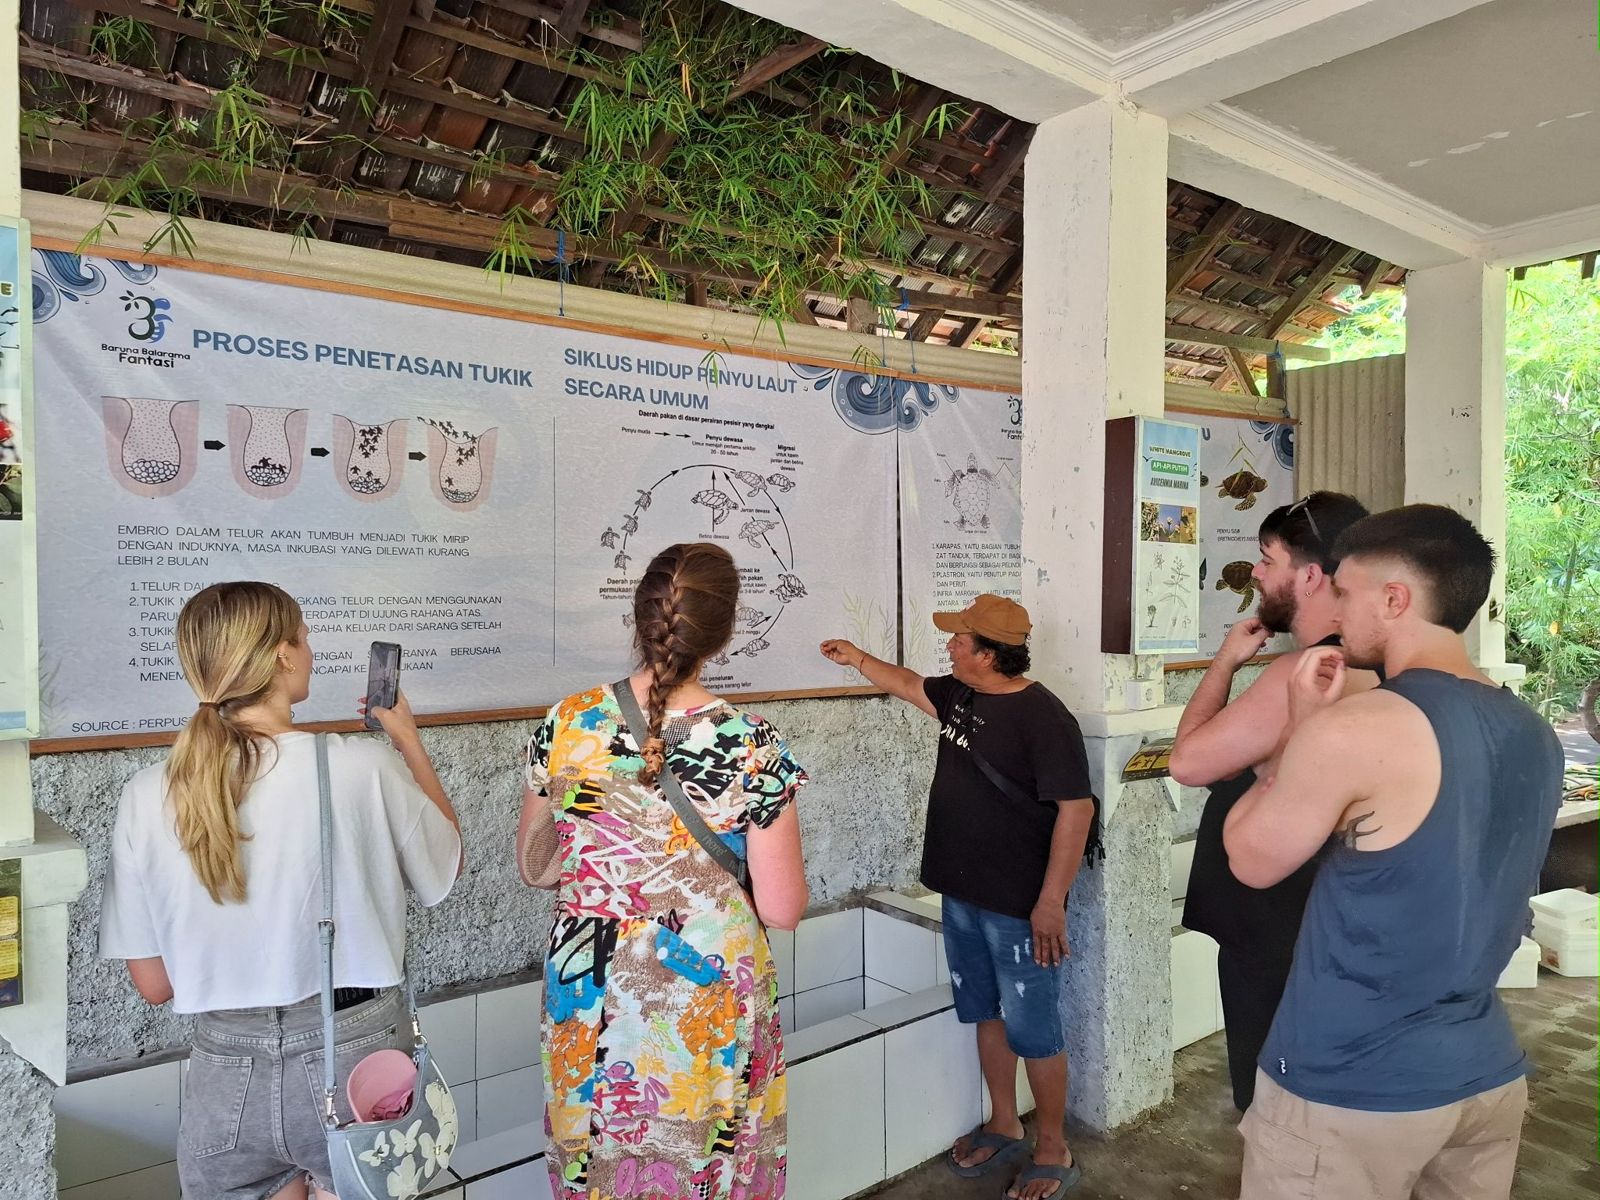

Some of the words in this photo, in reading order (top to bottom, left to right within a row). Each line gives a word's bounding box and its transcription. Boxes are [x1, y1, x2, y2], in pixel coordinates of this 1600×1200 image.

[101, 343, 139, 355] Baruna
[141, 348, 191, 360] Balarama
[119, 353, 175, 368] Fantasi
[193, 329, 309, 361] PROSES
[315, 344, 463, 379] PENETASAN
[468, 363, 533, 388] TUKIK
[564, 348, 632, 373] SIKLUS
[637, 361, 693, 380] HIDUP
[697, 366, 753, 388] PENYU
[757, 376, 797, 394] LAUT
[564, 378, 645, 402] SECARA
[650, 389, 709, 409] UMUM
[639, 409, 659, 418] Daerah
[755, 422, 775, 430] dangkal
[706, 434, 722, 442] Penyu
[777, 444, 795, 452] Migrasi
[1165, 448, 1191, 458] MANGROVE
[118, 525, 169, 536] EMBRIO
[176, 526, 220, 537] DALAM
[227, 528, 264, 538] TELUR
[270, 530, 301, 539] AKAN
[307, 530, 354, 541] TUMBUH
[360, 532, 406, 542] MENJADI
[411, 533, 438, 543] TUKIK
[118, 540, 173, 551] DENGAN
[179, 541, 242, 553] INDUKNYA,
[247, 543, 281, 553] MASA
[286, 544, 336, 554] INKUBASI
[341, 545, 372, 555] YANG
[376, 546, 424, 556] DILEWATI
[428, 547, 470, 557] KURANG
[118, 555, 153, 565] LEBIH
[156, 556, 164, 565] 2
[167, 556, 209, 566] BULAN
[140, 581, 181, 592] TELUR
[140, 596, 175, 606] TUKIK
[341, 596, 374, 606] TELUR
[378, 596, 422, 605] DENGAN
[426, 596, 502, 605] MENGGUNAKAN
[359, 610, 370, 618] DI
[372, 609, 408, 618] UJUNG
[410, 609, 454, 618] RAHANG
[140, 627, 175, 637] TUKIK
[307, 624, 343, 633] USAHA
[345, 623, 386, 632] KELUAR
[389, 622, 414, 632] DARI
[416, 621, 458, 631] SARANG
[461, 621, 502, 630] SETELAH
[313, 651, 353, 661] ENGAN
[450, 646, 502, 656] BERUSAHA
[140, 657, 175, 667] TUKIK
[310, 665, 352, 675] NCAPAI
[354, 664, 367, 673] KE
[71, 719, 129, 733] SOURCE
